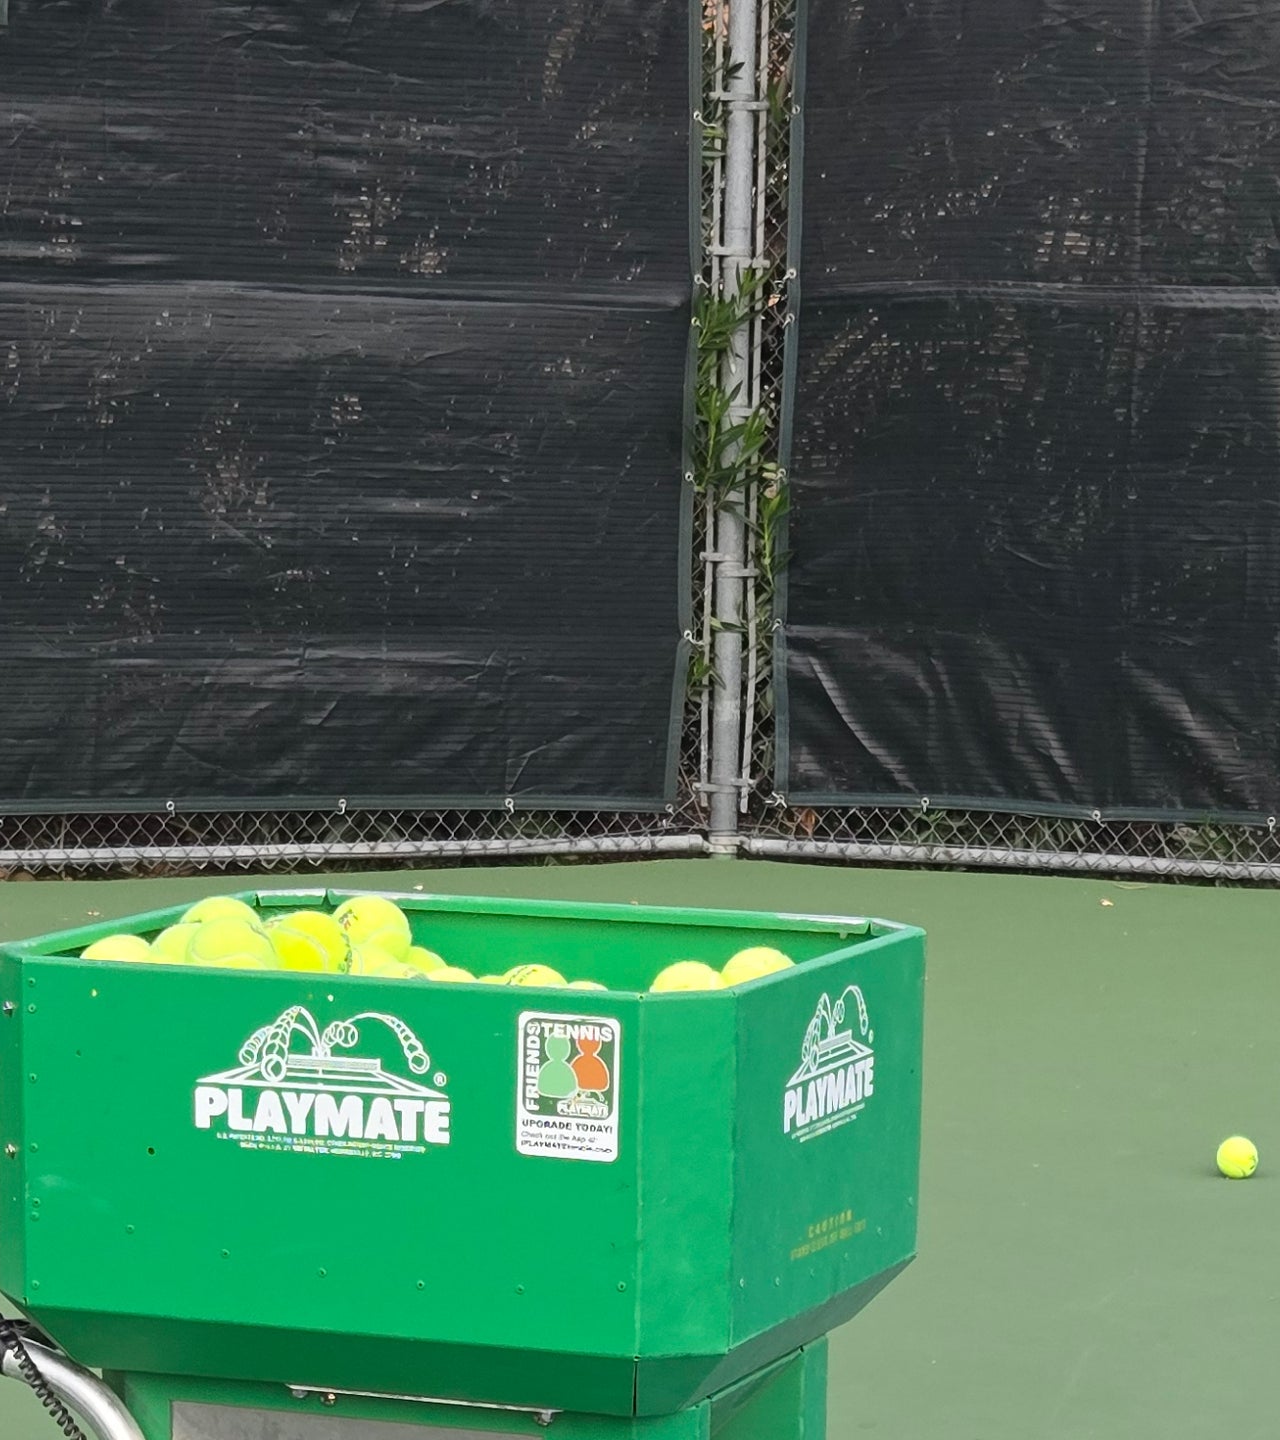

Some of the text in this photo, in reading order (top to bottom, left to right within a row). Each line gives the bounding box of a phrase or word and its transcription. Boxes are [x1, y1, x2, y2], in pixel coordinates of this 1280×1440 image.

[526, 1021, 541, 1111] FRIENDS
[541, 1022, 613, 1042] TENNIS
[194, 1086, 450, 1144] PLAYMATE
[784, 1056, 875, 1134] PLAYMATE
